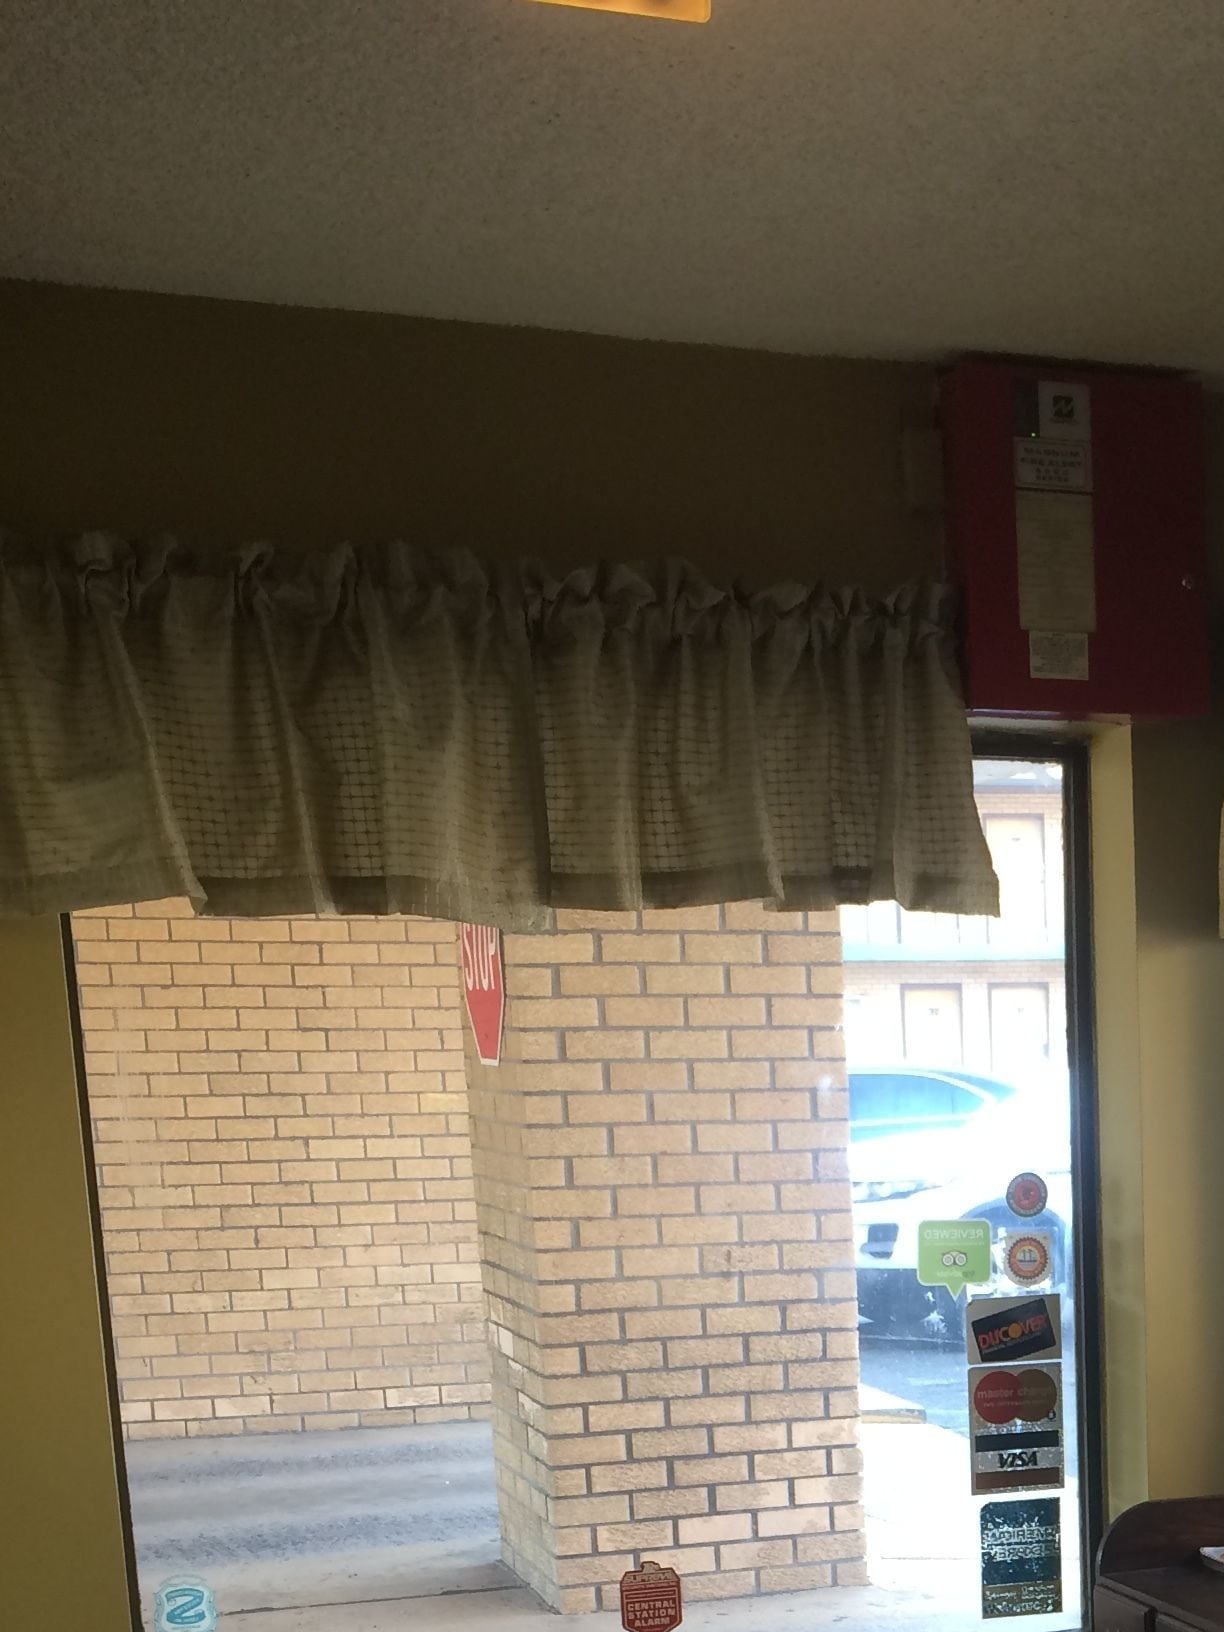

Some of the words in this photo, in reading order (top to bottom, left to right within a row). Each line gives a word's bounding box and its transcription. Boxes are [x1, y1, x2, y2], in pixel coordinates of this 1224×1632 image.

[463, 923, 496, 991] STOP
[977, 1313, 1048, 1350] DISCOVER
[976, 1387, 1015, 1400] master
[998, 1450, 1040, 1469] VISA
[627, 1600, 675, 1611] CENTRAL
[627, 1608, 675, 1619] STATION
[634, 1617, 670, 1627] ALARM
